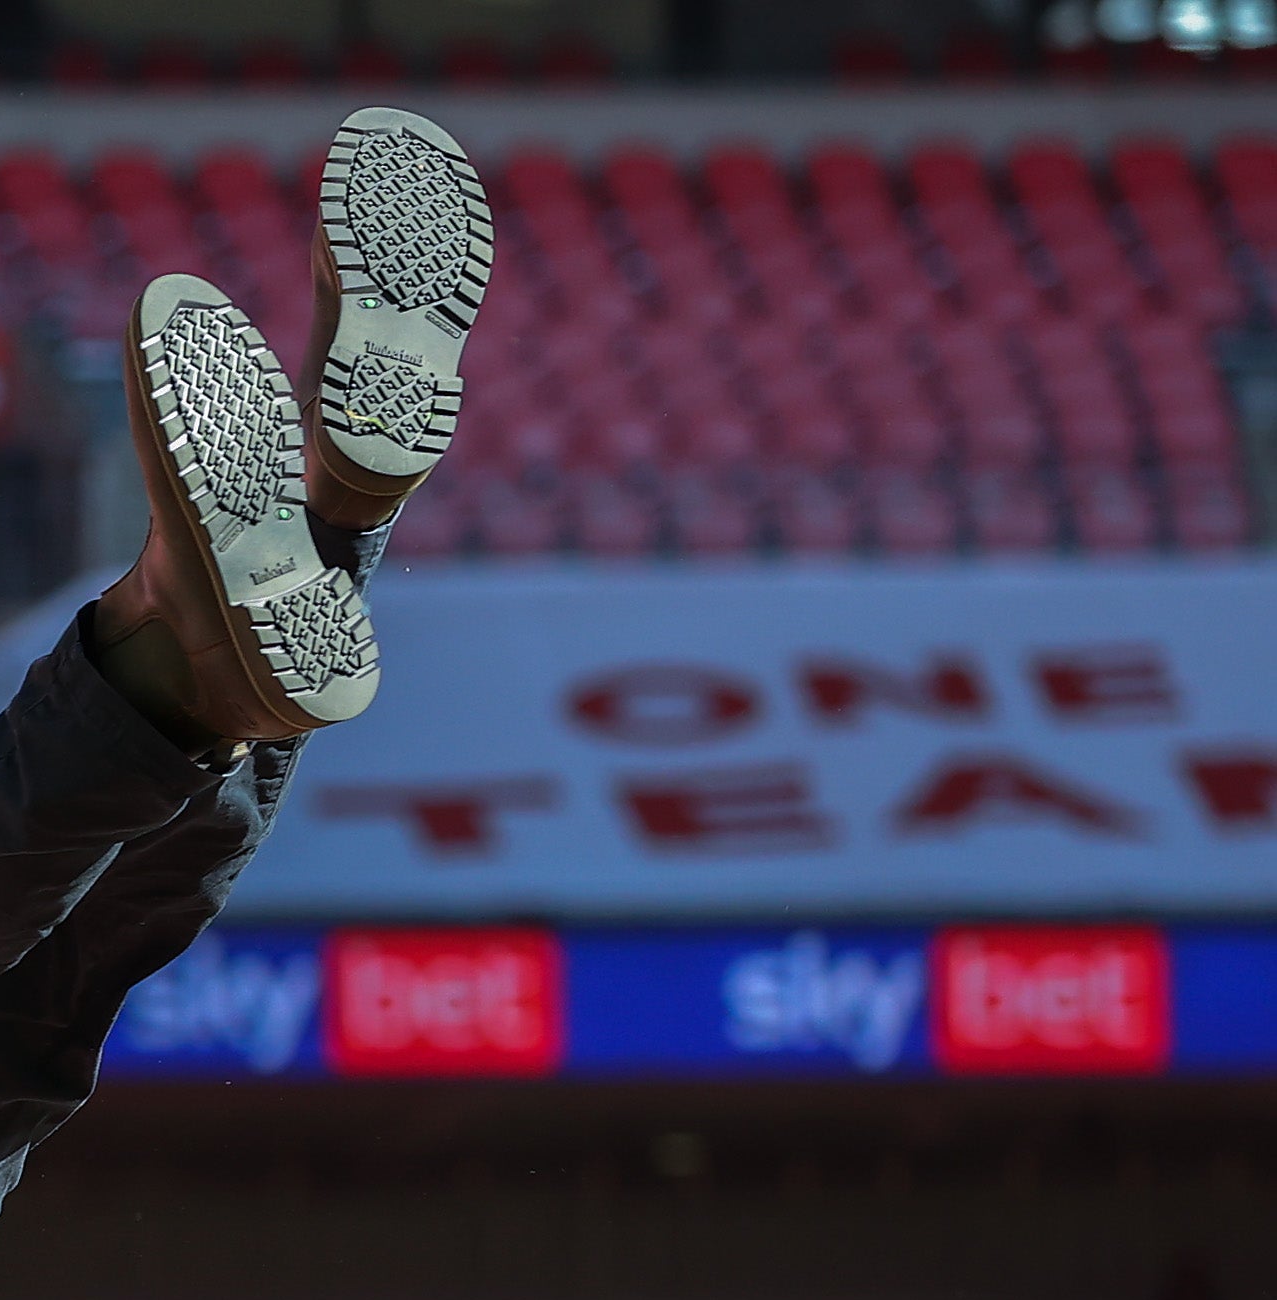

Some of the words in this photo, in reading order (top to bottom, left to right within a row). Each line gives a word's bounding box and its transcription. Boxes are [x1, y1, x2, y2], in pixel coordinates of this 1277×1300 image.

[560, 645, 1186, 750] ONE
[128, 932, 321, 1073] sky
[346, 934, 542, 1050] bet
[724, 931, 926, 1071] sky
[948, 932, 1141, 1050] bet
